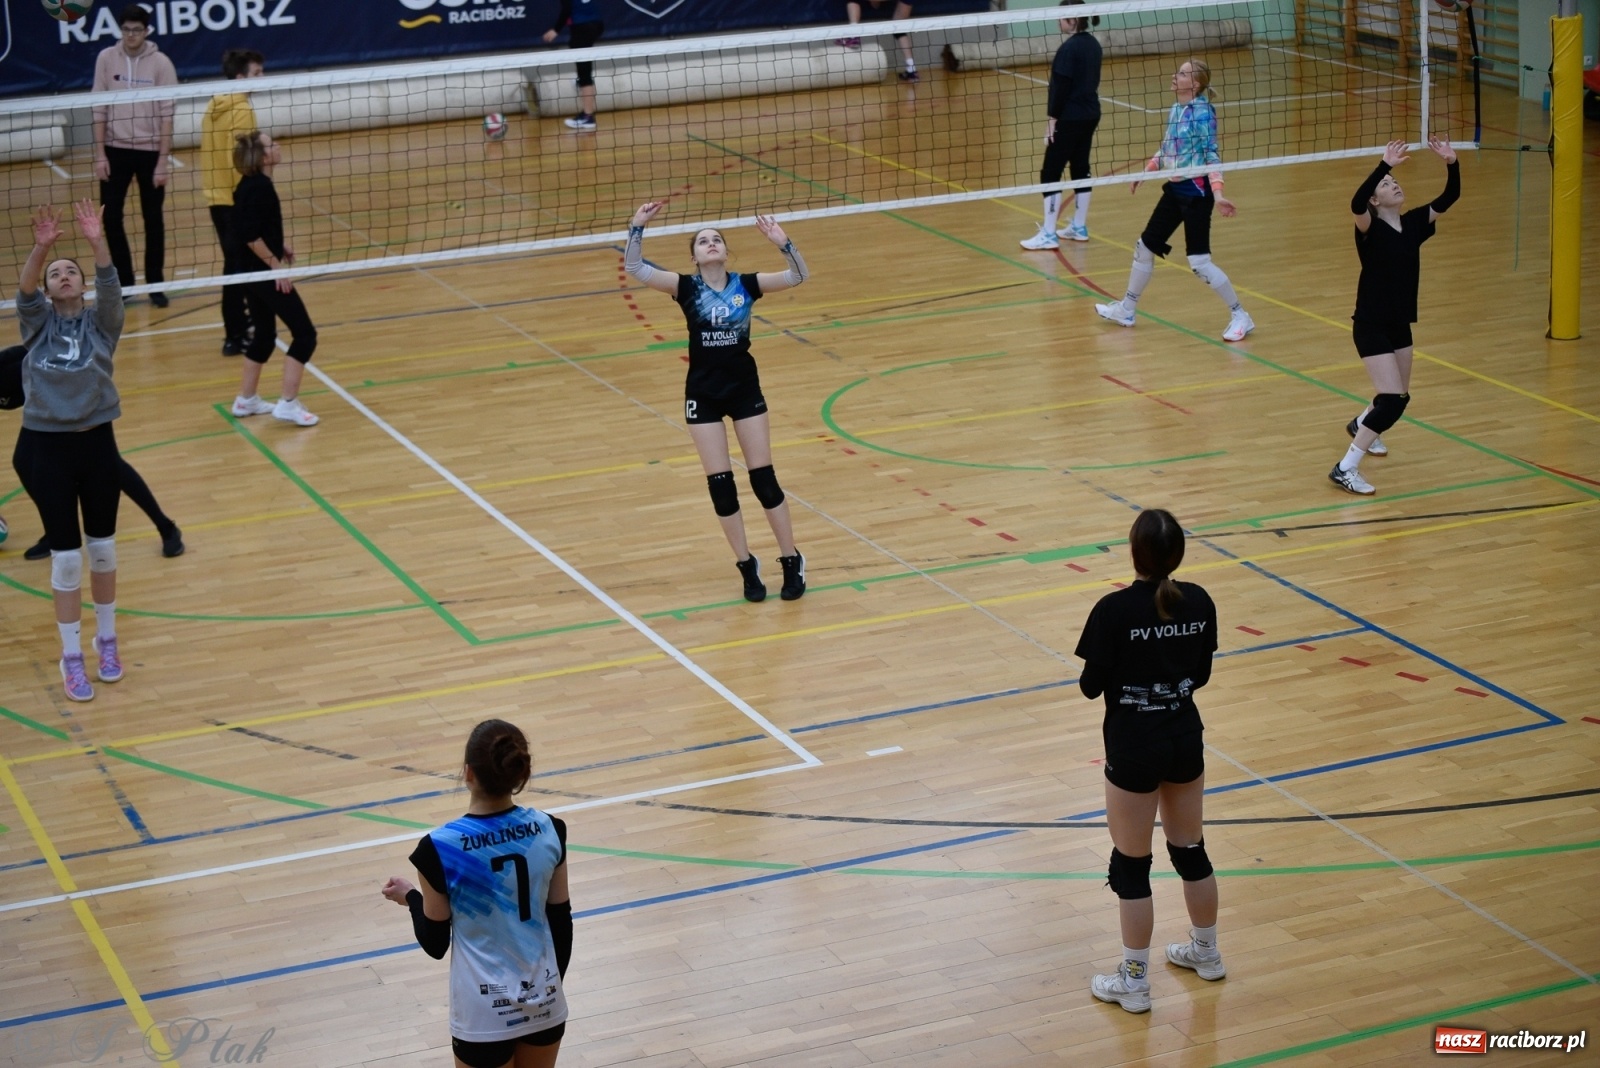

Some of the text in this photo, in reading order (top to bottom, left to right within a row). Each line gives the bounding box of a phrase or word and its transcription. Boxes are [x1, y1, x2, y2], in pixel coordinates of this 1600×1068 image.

[449, 5, 526, 24] RACIBÓRZ
[711, 306, 730, 326] 12
[701, 332, 711, 340] PV
[702, 338, 738, 347] KRAPKOWICE
[686, 400, 698, 418] 12
[1130, 621, 1207, 641] PV VOLLEY
[459, 822, 542, 852] ŻUKLIŃSKA
[490, 853, 532, 922] 7
